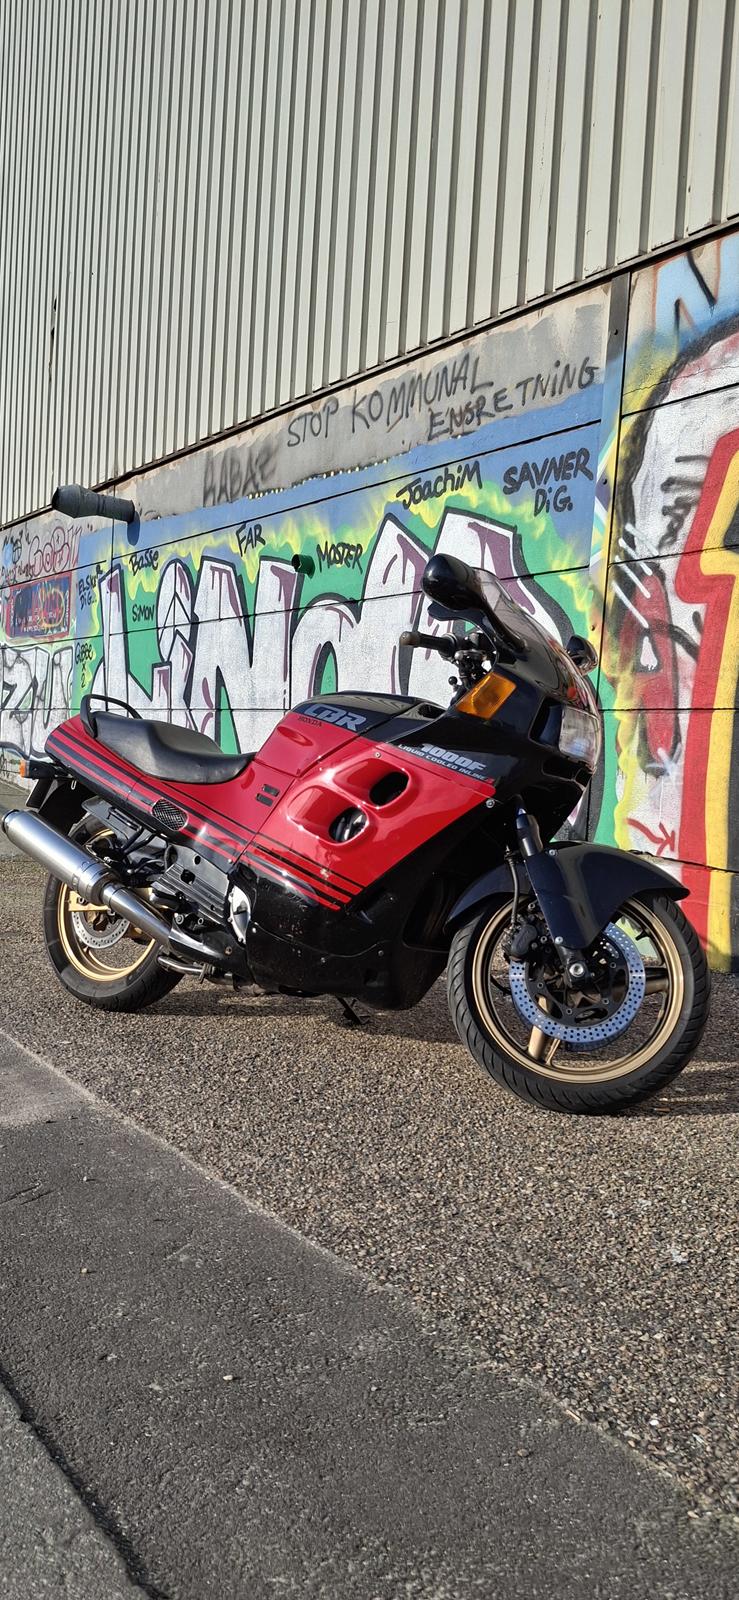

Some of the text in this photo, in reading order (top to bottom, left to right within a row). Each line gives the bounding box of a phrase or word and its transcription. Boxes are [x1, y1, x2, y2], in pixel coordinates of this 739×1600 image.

[287, 352, 494, 447] STOP KOMMUNAL
[502, 448, 594, 495] SAVNER
[236, 521, 266, 557] FAR
[316, 541, 363, 574] MOSTER
[298, 716, 322, 728] HONDA
[304, 703, 367, 732] CBR
[397, 744, 425, 757] LIQUID
[426, 753, 458, 770] COOLED
[458, 766, 486, 780] INLINE
[421, 743, 487, 770] 1000F
